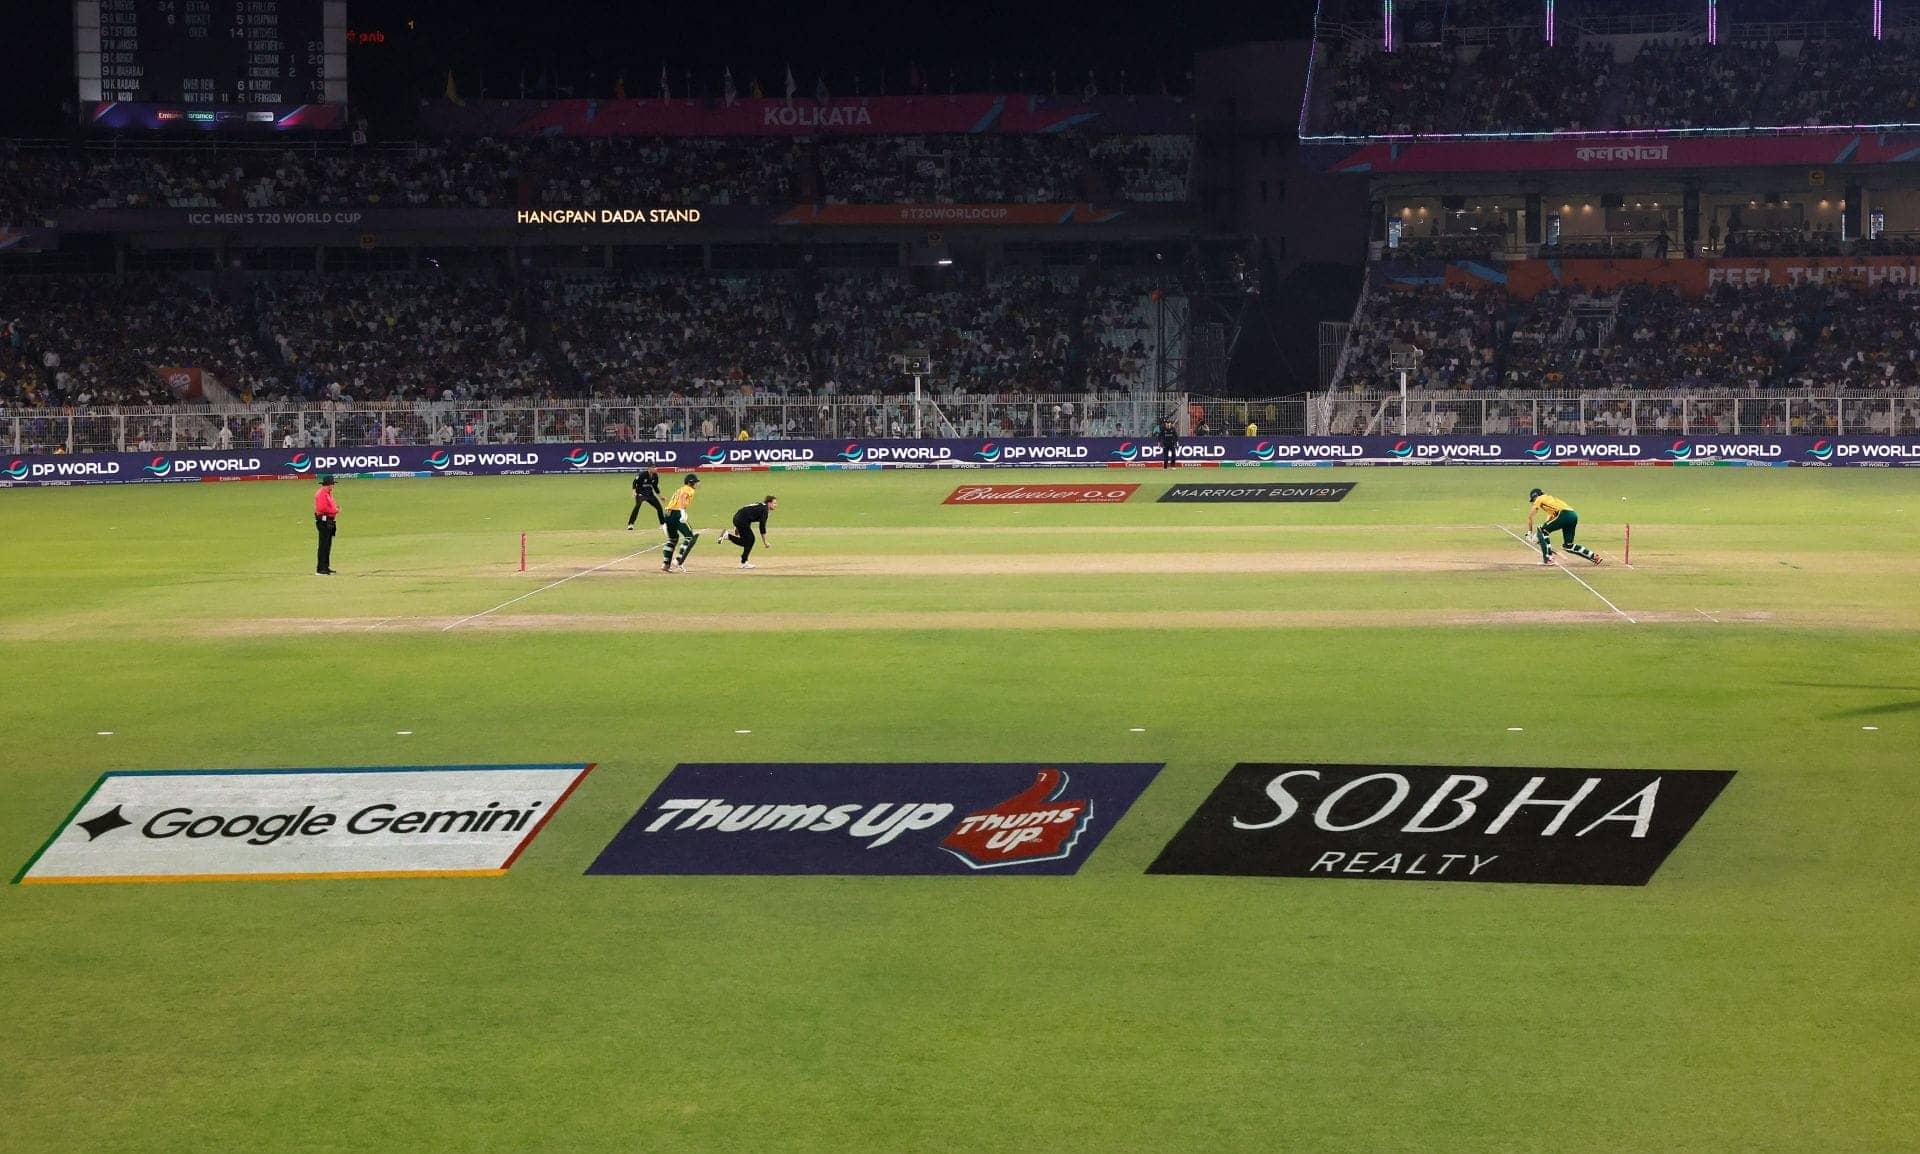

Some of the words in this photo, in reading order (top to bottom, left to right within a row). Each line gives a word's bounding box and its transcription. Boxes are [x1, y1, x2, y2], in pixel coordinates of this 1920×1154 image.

[764, 106, 873, 126] KOLKATA
[1576, 145, 1669, 161] কলকাতা
[188, 213, 211, 224] ICC
[257, 213, 281, 224] T20
[283, 212, 332, 224] WORLD
[335, 212, 362, 223] CUP
[517, 209, 596, 224] HANGPAN
[601, 209, 646, 223] DADA
[650, 208, 701, 223] STAND
[592, 451, 615, 464] DP
[616, 450, 677, 463] WORLD
[729, 449, 752, 461] DP
[753, 448, 814, 461] WORLD
[867, 447, 890, 460] DP
[891, 447, 952, 459] WORLD
[1004, 446, 1026, 459] DP
[1028, 446, 1088, 458] WORLD
[1141, 445, 1164, 458] DP
[1278, 445, 1301, 457] DP
[1302, 445, 1364, 457] WORLD
[1417, 444, 1440, 457] DP
[1441, 444, 1502, 457] WORLD
[1555, 444, 1578, 457] DP
[1579, 444, 1641, 457] WORLD
[1695, 444, 1718, 457] DP
[1719, 444, 1782, 457] WORLD
[1837, 444, 1860, 457] DP
[1861, 444, 1920, 457] WORLD
[174, 460, 198, 472] DP
[199, 458, 261, 472] WORLD
[314, 456, 338, 469] DP
[339, 455, 401, 468] WORLD
[453, 454, 477, 466] DP
[477, 453, 539, 466] WORLD
[32, 463, 58, 476] DP
[57, 461, 120, 475] WORLD
[955, 487, 1080, 501] Budweiser
[1083, 490, 1127, 499] 0.0
[1171, 488, 1266, 497] MARRIOTT
[1269, 488, 1343, 497] BONVOY
[1232, 768, 1664, 838] SOBHA
[142, 805, 336, 846] Google
[346, 800, 542, 837] Gemini
[1308, 851, 1500, 876] REALTY
